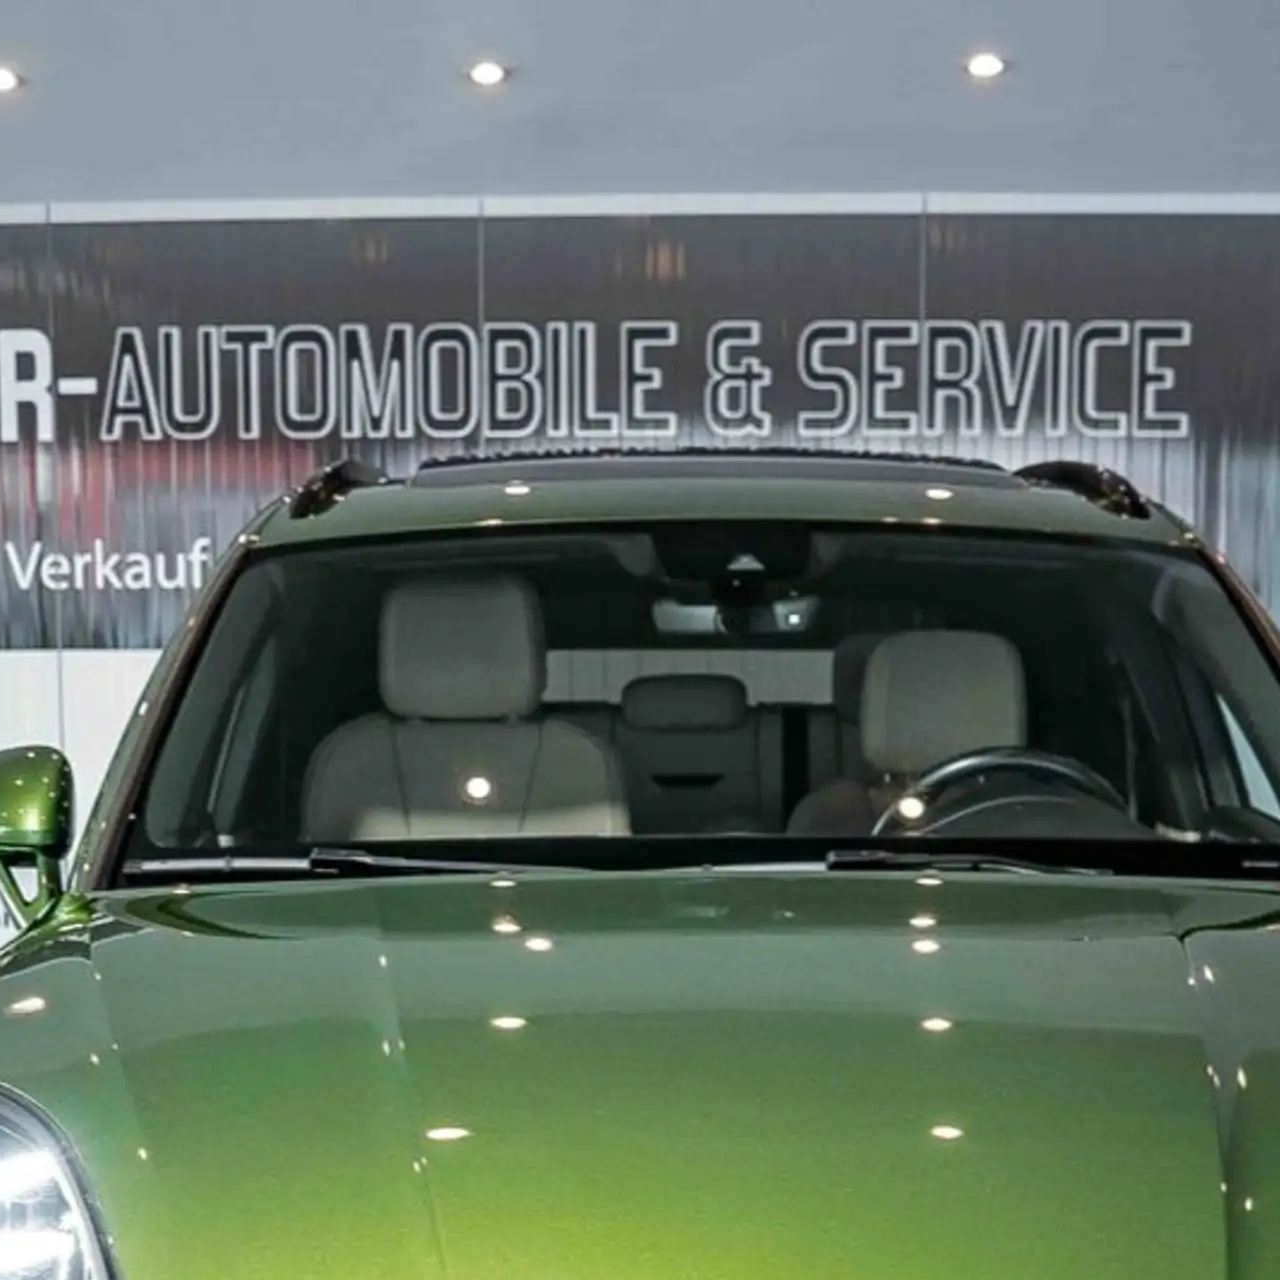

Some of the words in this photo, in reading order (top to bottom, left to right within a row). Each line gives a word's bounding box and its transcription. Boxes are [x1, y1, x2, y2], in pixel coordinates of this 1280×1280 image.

[704, 320, 772, 437] &
[797, 319, 1192, 438] SERVICE
[4, 537, 214, 591] Verkauf
